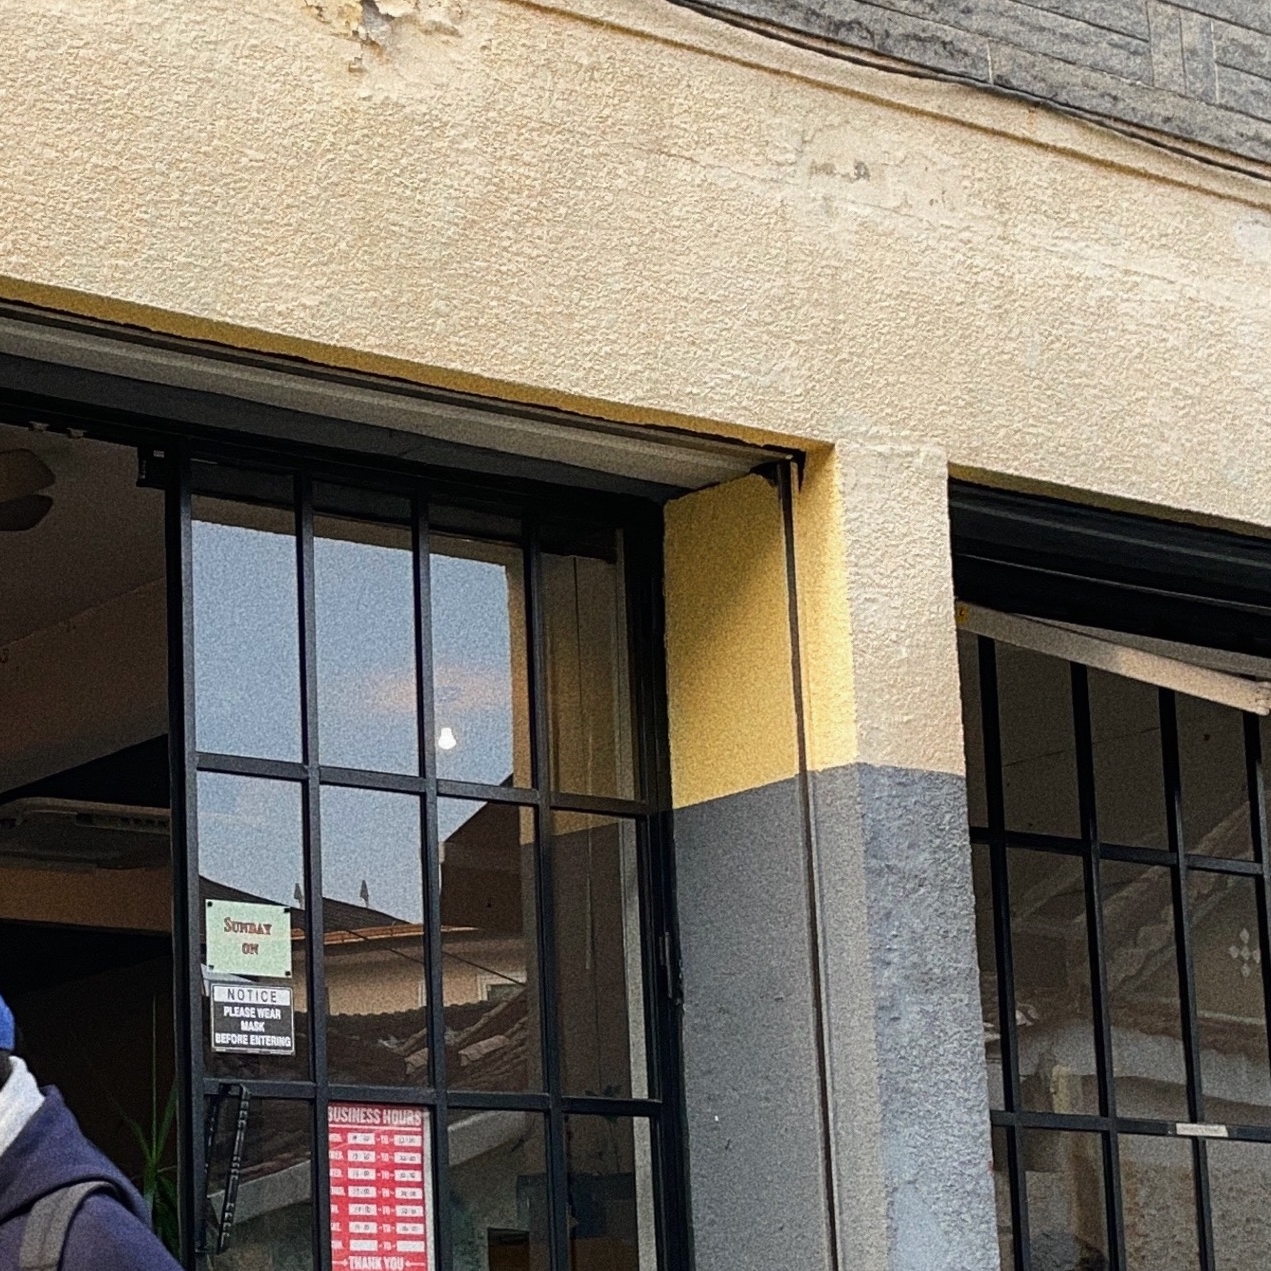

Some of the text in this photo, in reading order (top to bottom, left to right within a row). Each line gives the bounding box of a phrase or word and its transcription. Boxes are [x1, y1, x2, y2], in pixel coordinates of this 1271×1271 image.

[227, 988, 278, 1004] NOTICE
[223, 1005, 282, 1021] PLEASE WEAR
[240, 1020, 266, 1033] MASK
[214, 1032, 292, 1048] BEFORE ENTERING
[328, 1106, 422, 1127] BUSINESS HOURS
[348, 1255, 404, 1271] THANK YOU
